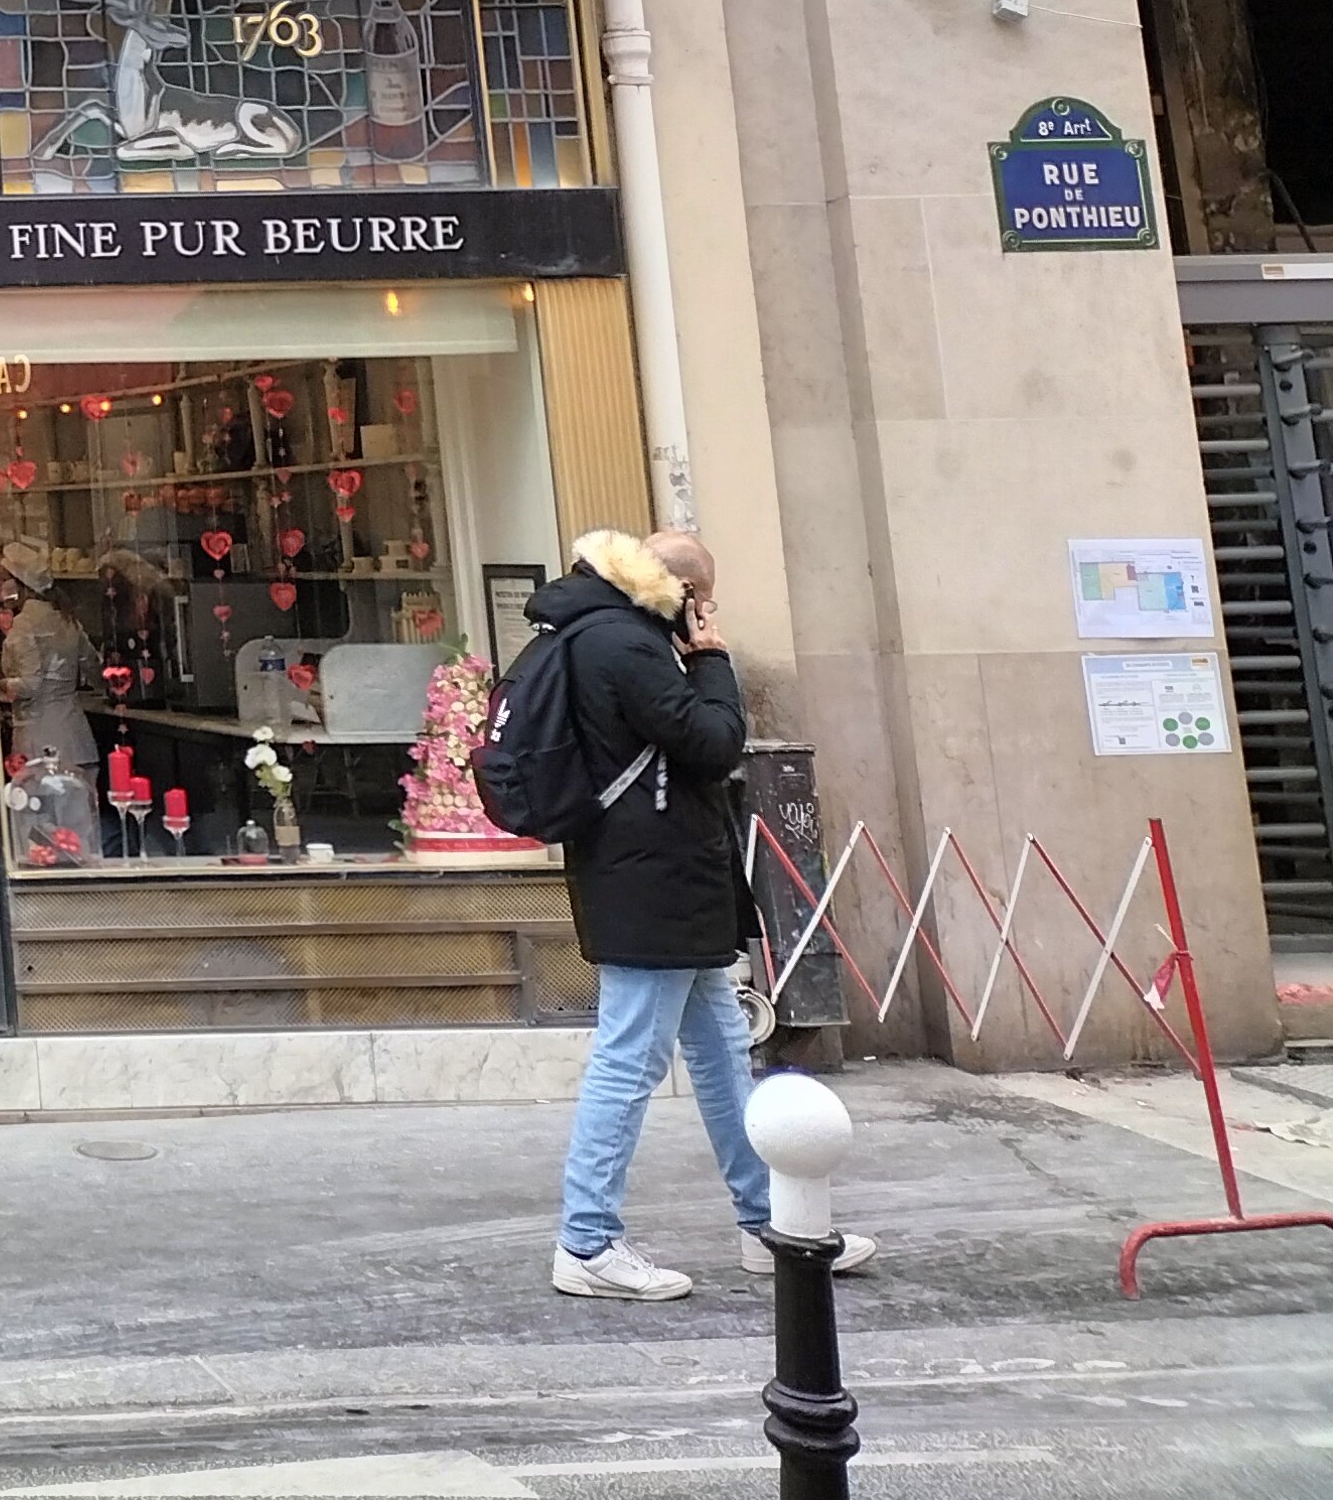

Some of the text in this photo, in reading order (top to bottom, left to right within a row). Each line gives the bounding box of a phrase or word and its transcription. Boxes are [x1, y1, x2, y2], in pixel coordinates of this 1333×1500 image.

[232, 0, 324, 62] 1763
[1042, 162, 1100, 186] RUE
[1064, 187, 1084, 201] DE
[1013, 205, 1141, 230] PONTHIEU
[9, 221, 123, 259] FINE
[139, 218, 248, 257] PUR
[262, 214, 466, 254] BEURRE
